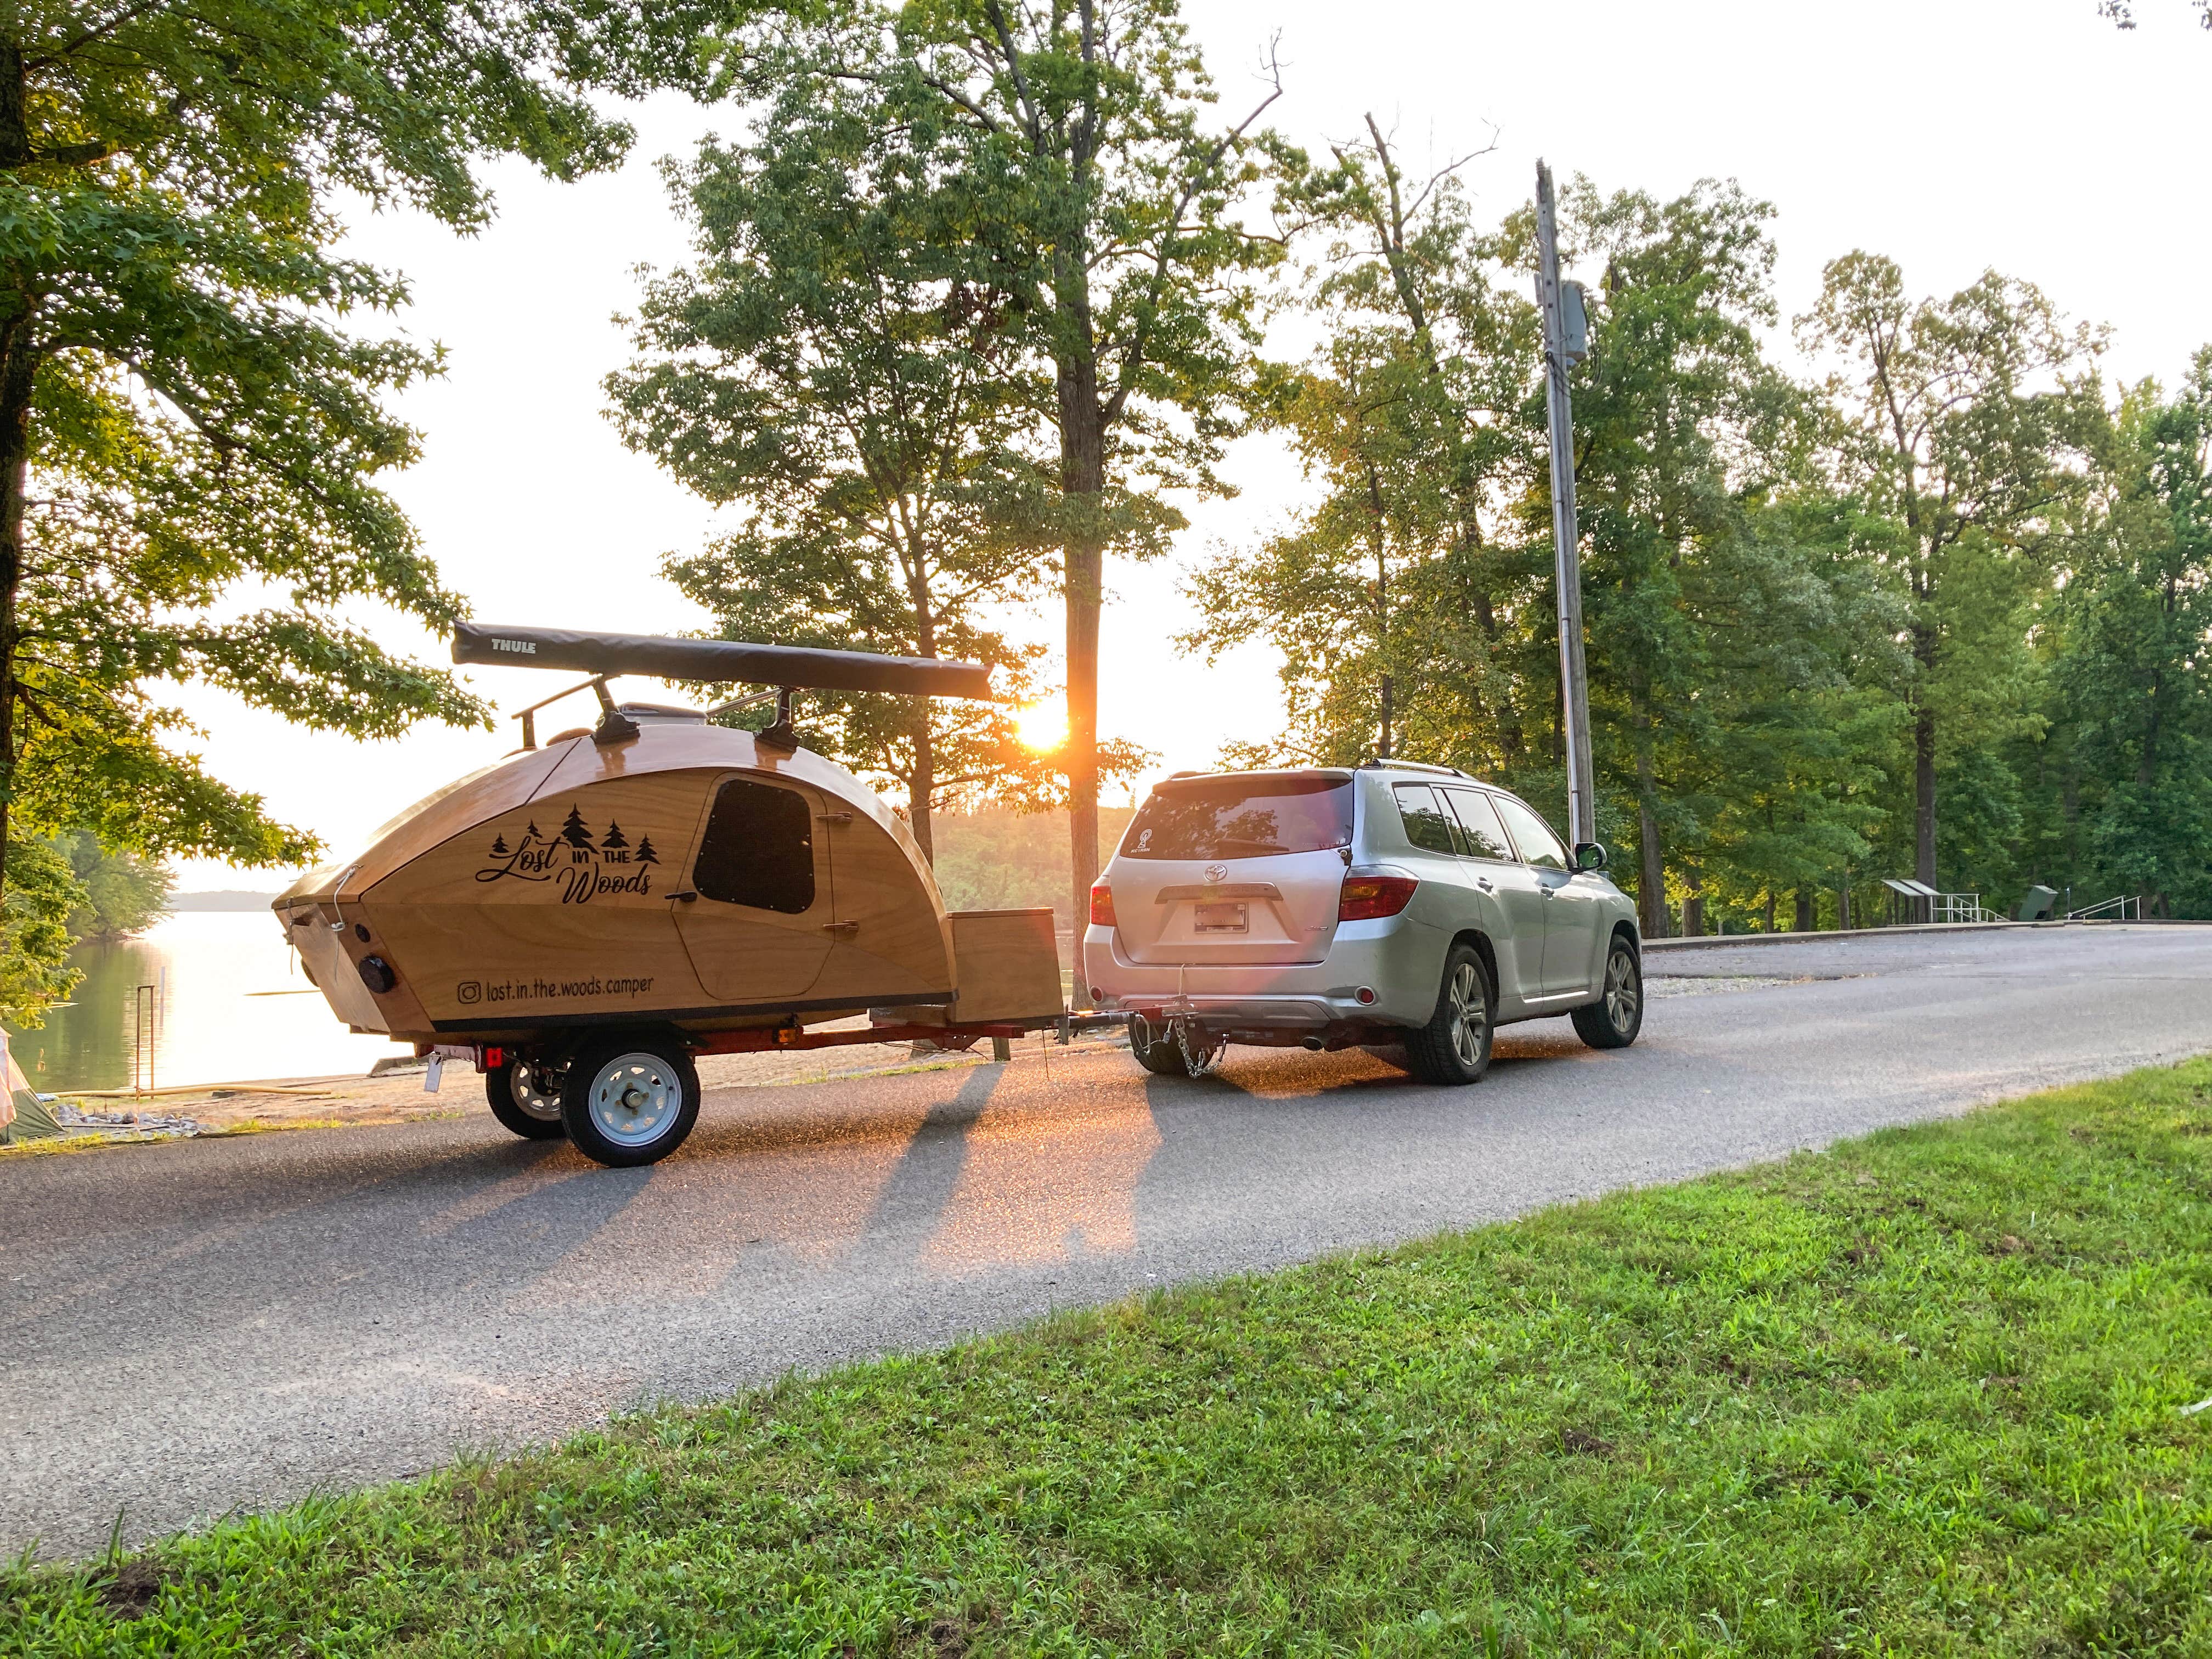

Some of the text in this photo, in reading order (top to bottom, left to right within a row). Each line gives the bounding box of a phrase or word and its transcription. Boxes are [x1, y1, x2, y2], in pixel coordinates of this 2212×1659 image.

[492, 638, 536, 654] THULE
[475, 836, 630, 882] Lost IN THE
[556, 861, 653, 904] Woods
[487, 975, 654, 1001] lost.in.the.woods.camper
